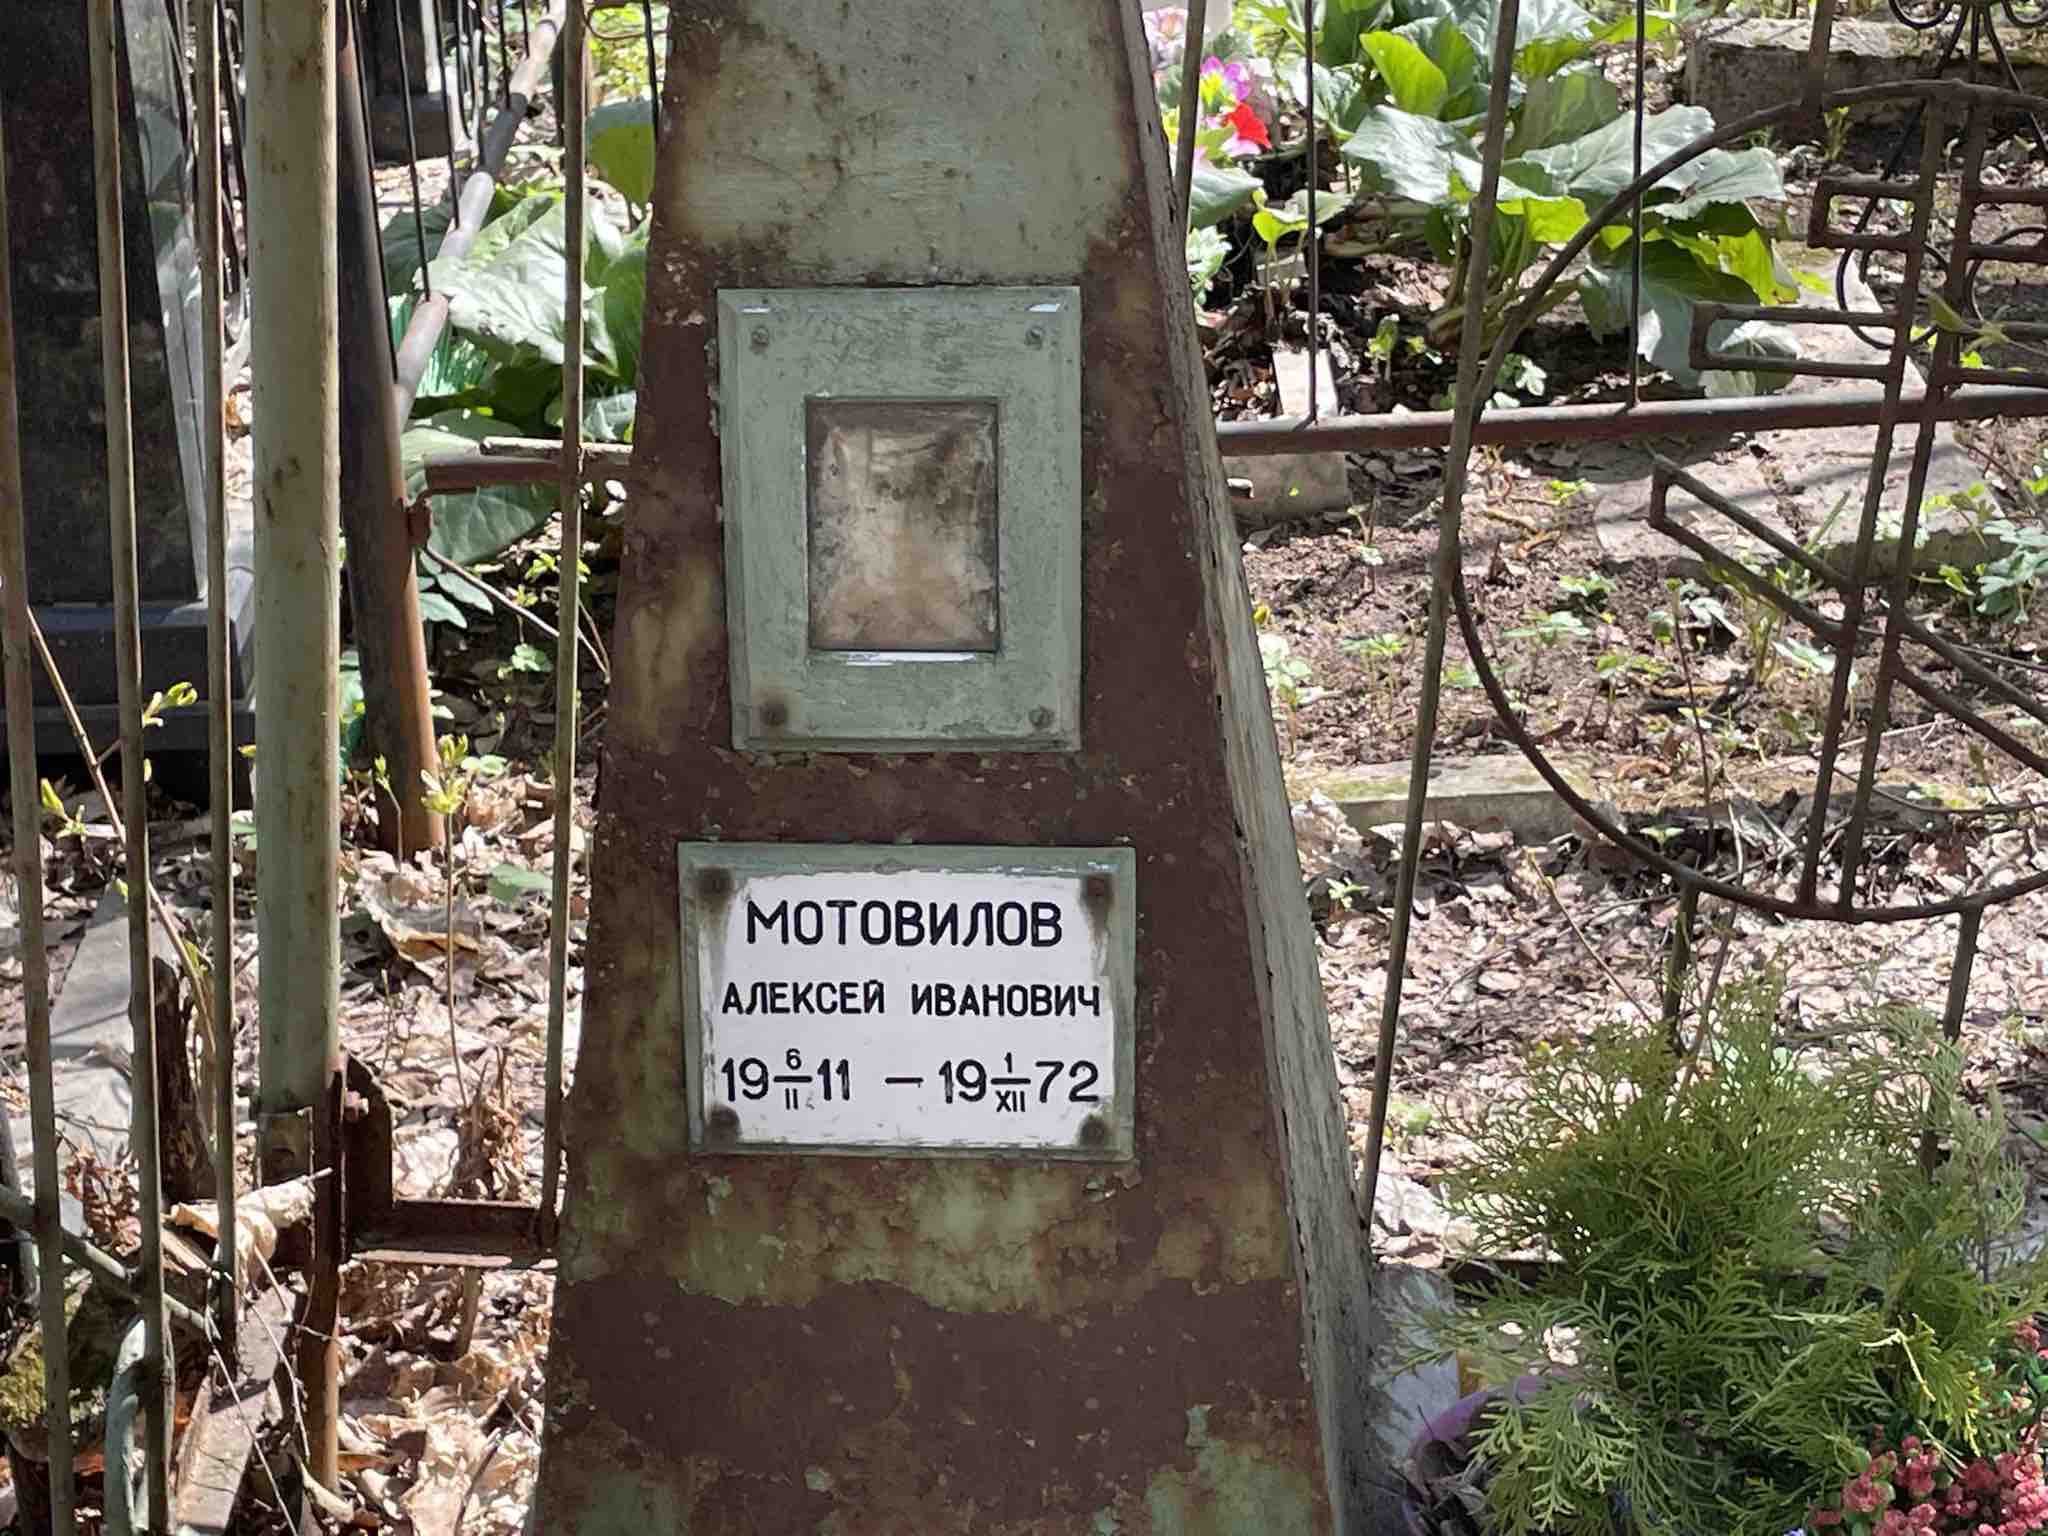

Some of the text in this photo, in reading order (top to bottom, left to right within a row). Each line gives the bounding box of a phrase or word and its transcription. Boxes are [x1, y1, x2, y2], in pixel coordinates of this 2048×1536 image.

[746, 899, 1063, 948] МОТОВИЛОВ
[721, 979, 1100, 1017] АЛЕКСЕЙ ИВАНОВИЧ
